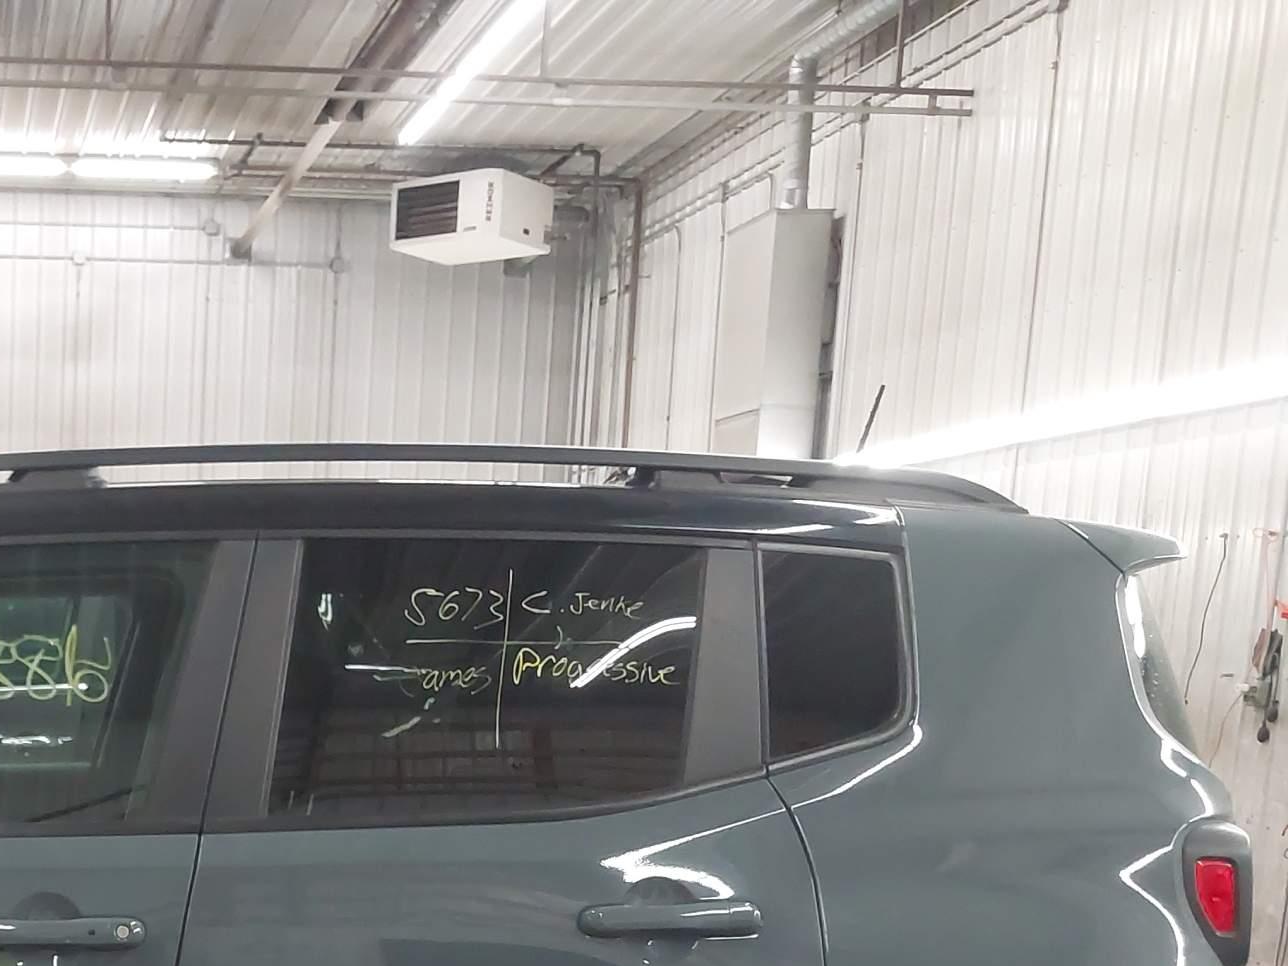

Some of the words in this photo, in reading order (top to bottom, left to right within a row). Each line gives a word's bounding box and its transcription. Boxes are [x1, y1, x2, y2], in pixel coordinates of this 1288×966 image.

[404, 587, 504, 630] 5673
[399, 666, 493, 697] ames
[512, 647, 681, 688] Progessive
